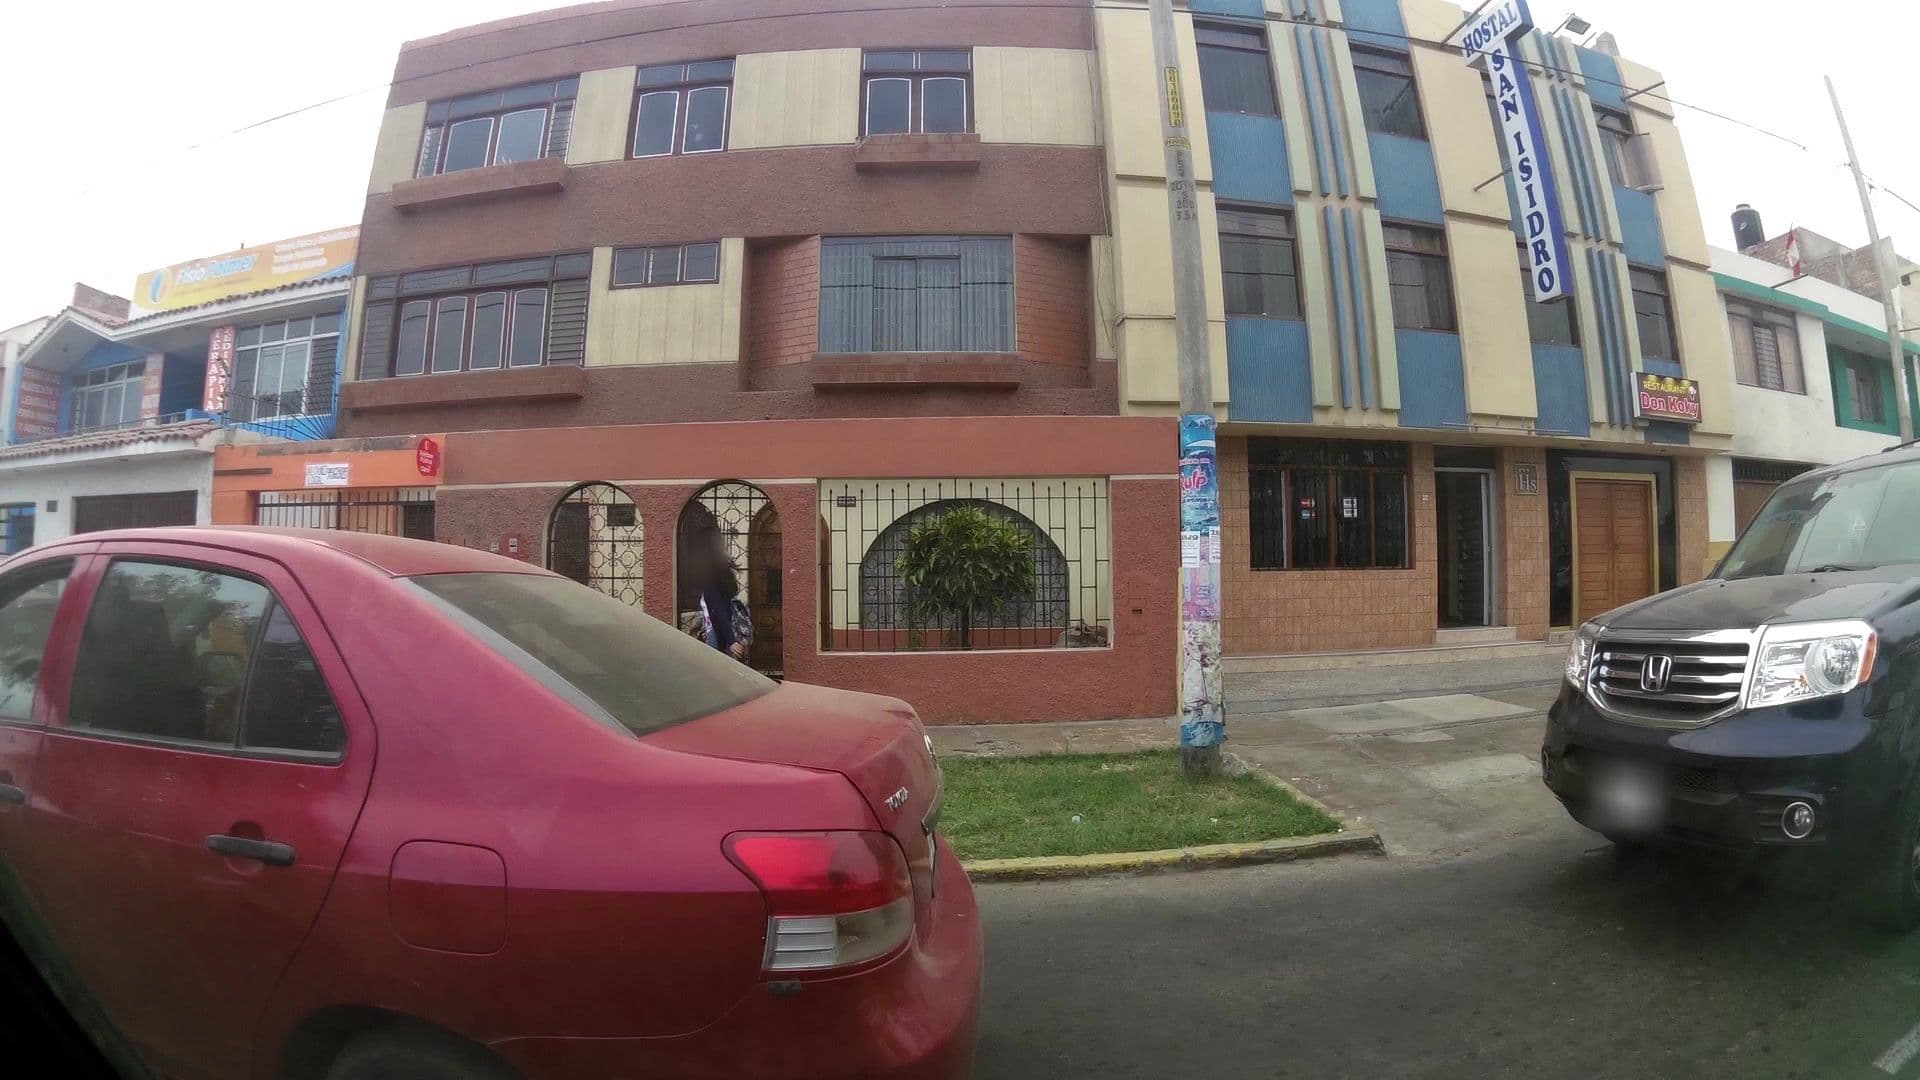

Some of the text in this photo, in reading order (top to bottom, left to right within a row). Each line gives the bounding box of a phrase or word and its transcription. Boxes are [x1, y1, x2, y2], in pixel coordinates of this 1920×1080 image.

[1462, 2, 1517, 58] HOSTAL
[1491, 48, 1555, 293] SAN ISIDRO
[1640, 391, 1699, 418] Don Koky
